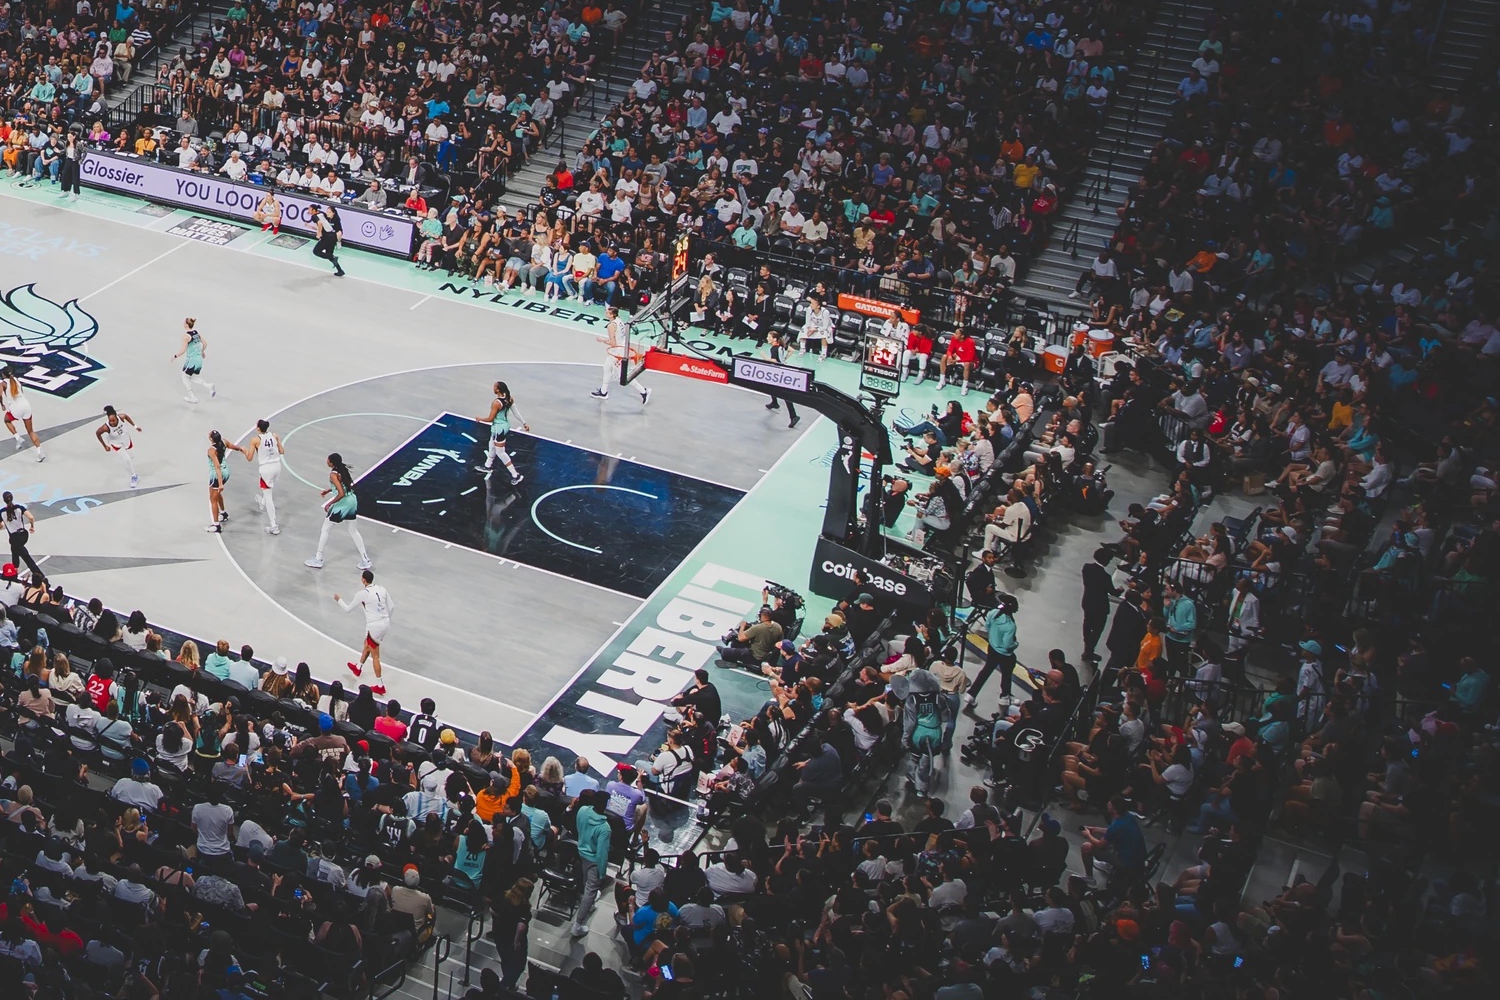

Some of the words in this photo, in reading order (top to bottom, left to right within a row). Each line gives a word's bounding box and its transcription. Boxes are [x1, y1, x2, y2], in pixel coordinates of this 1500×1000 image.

[82, 158, 144, 187] Glossier.
[176, 178, 212, 201] YOU
[188, 224, 228, 237] LIVES
[194, 218, 240, 233] BLACK
[168, 227, 228, 245] MATTER
[674, 254, 687, 280] 24
[873, 350, 894, 365] 24
[740, 364, 801, 388] Glossier.
[264, 438, 274, 448] 41
[393, 454, 445, 487] WNBA
[542, 562, 773, 778] LIBERTY
[89, 681, 104, 695] 22
[418, 727, 427, 743] 0
